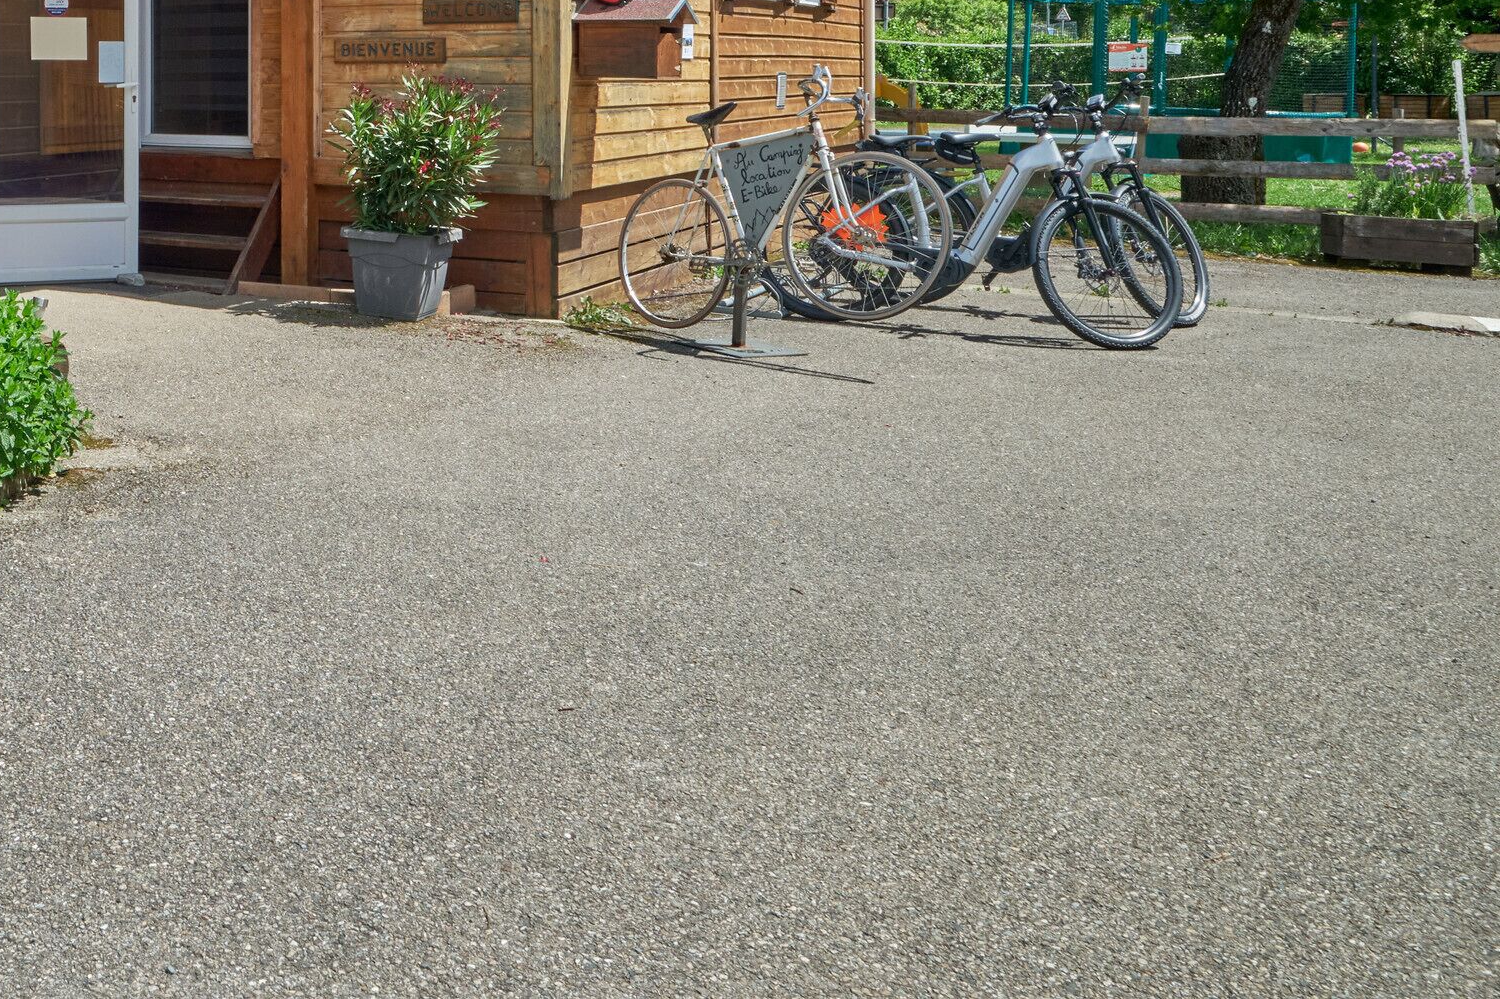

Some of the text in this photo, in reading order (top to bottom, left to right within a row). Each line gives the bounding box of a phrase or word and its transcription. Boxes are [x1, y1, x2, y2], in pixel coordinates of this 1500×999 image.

[341, 41, 436, 57] BIENVENUE
[759, 143, 804, 165] Camping
[741, 182, 781, 204] E-Bike
